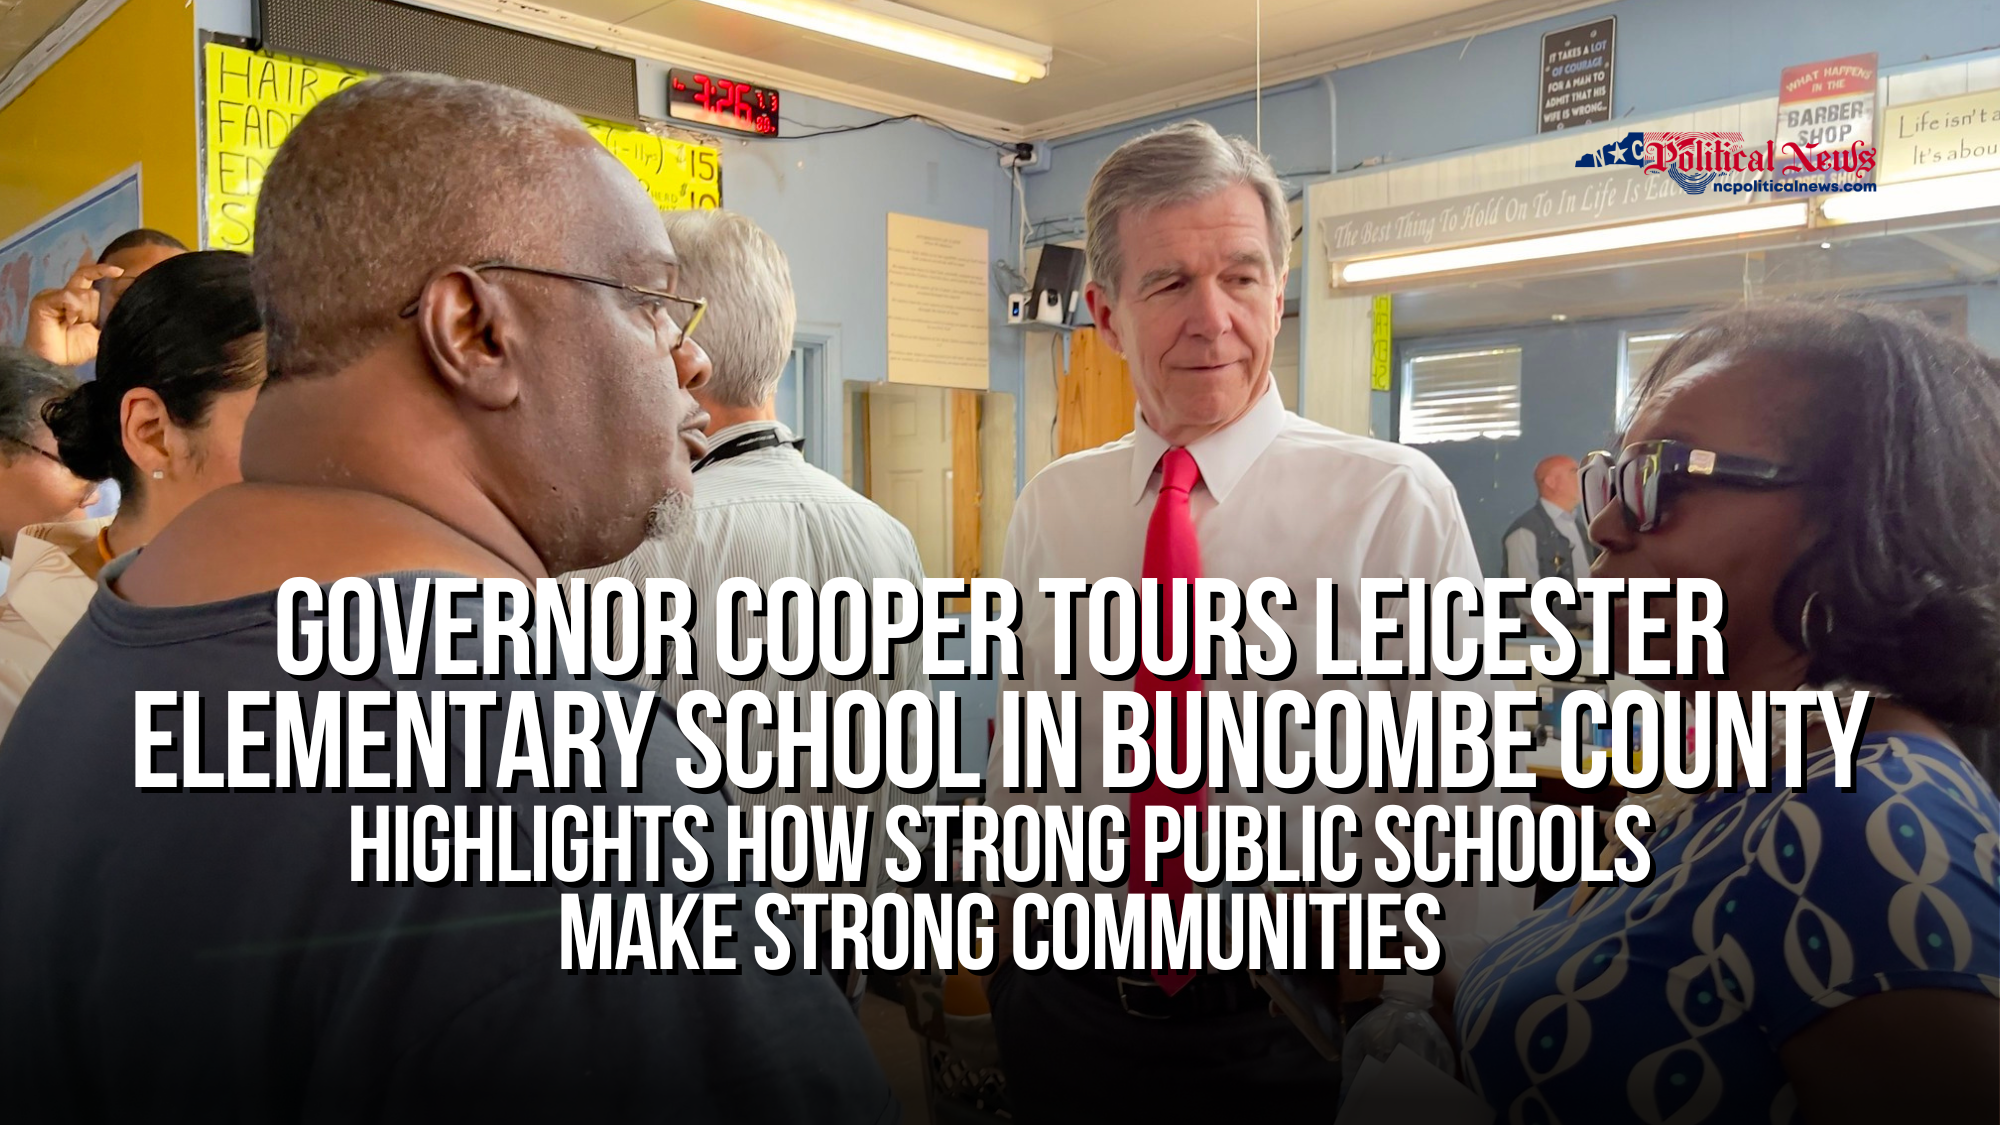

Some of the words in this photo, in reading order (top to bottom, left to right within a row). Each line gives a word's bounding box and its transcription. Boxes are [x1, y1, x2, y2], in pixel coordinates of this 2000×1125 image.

[1549, 53, 1557, 63] IT
[1558, 46, 1581, 60] TAKES
[1583, 45, 1589, 54] A
[1591, 40, 1607, 53] LOT
[220, 52, 319, 105] HAIR
[1552, 66, 1563, 77] OF
[1565, 56, 1603, 74] COURAGE
[1786, 70, 1819, 92] WHAT
[1823, 65, 1873, 80] HAPPENS
[1548, 81, 1564, 93] FOR
[1565, 80, 1571, 89] A
[1573, 74, 1591, 87] MAN
[1593, 71, 1605, 81] TO
[1812, 83, 1822, 93] IN
[1828, 79, 1846, 90] THE
[693, 73, 751, 128] 3:26
[1545, 94, 1570, 108] ADMIT
[1572, 88, 1592, 102] THAT
[1593, 85, 1606, 97] HIS
[218, 100, 305, 149] FAD
[1544, 110, 1561, 123] WIFE
[1562, 108, 1570, 119] IS
[1787, 101, 1864, 128] BARBER
[1899, 111, 1939, 139] Life
[1945, 108, 1987, 128] isn't
[1797, 124, 1852, 147] SHOP
[1913, 145, 1942, 165] It's
[1947, 138, 1998, 160] abou
[1334, 219, 1357, 248] The
[1360, 220, 1391, 244] Best
[1395, 211, 1436, 243] Thing
[1439, 206, 1458, 232] To
[1460, 196, 1504, 231] Hold
[1505, 197, 1527, 222] On
[1532, 190, 1553, 218] To
[1557, 189, 1577, 215] In
[1580, 178, 1617, 218] Life
[1622, 177, 1639, 204] Is
